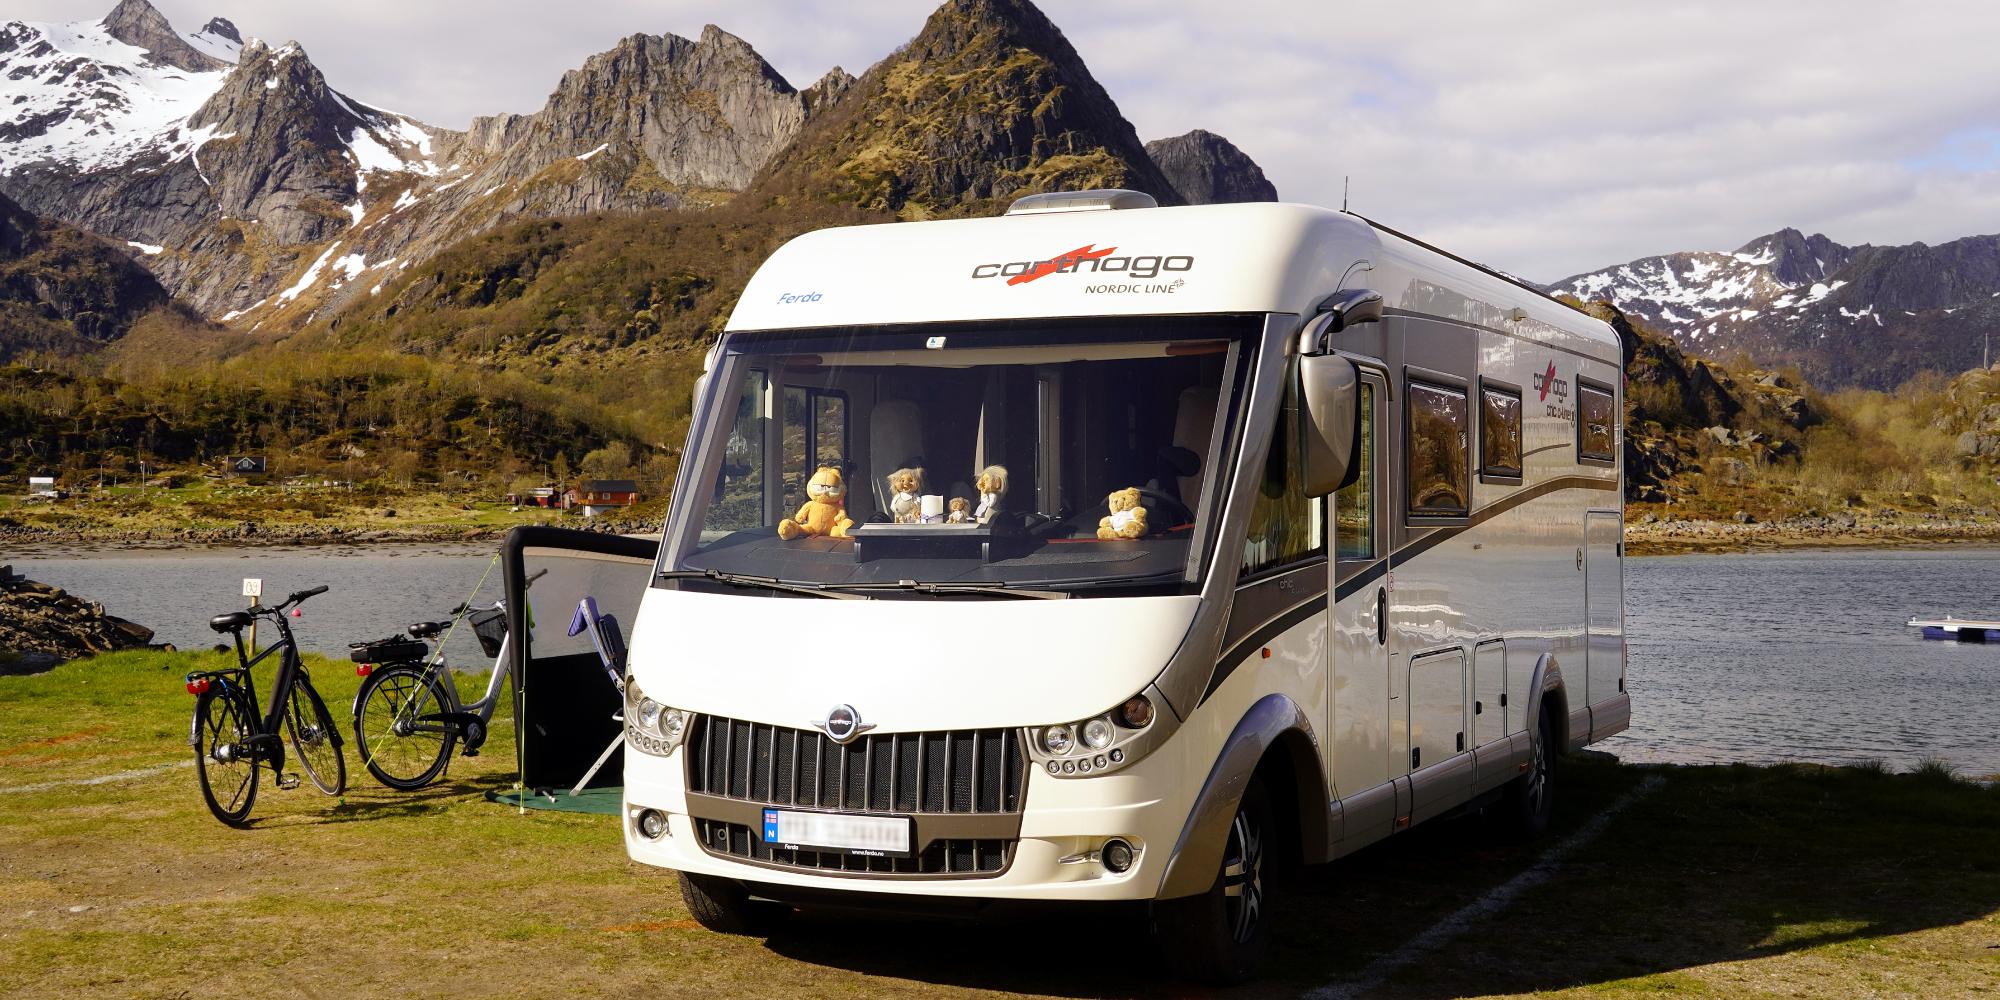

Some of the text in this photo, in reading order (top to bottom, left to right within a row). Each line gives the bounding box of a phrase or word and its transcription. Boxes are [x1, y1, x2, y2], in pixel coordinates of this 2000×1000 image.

[972, 255, 1194, 279] carthago
[1085, 284, 1175, 294] NORDIC LINE
[777, 291, 824, 305] Ferda
[767, 830, 775, 838] N
[784, 843, 799, 851] Ferda
